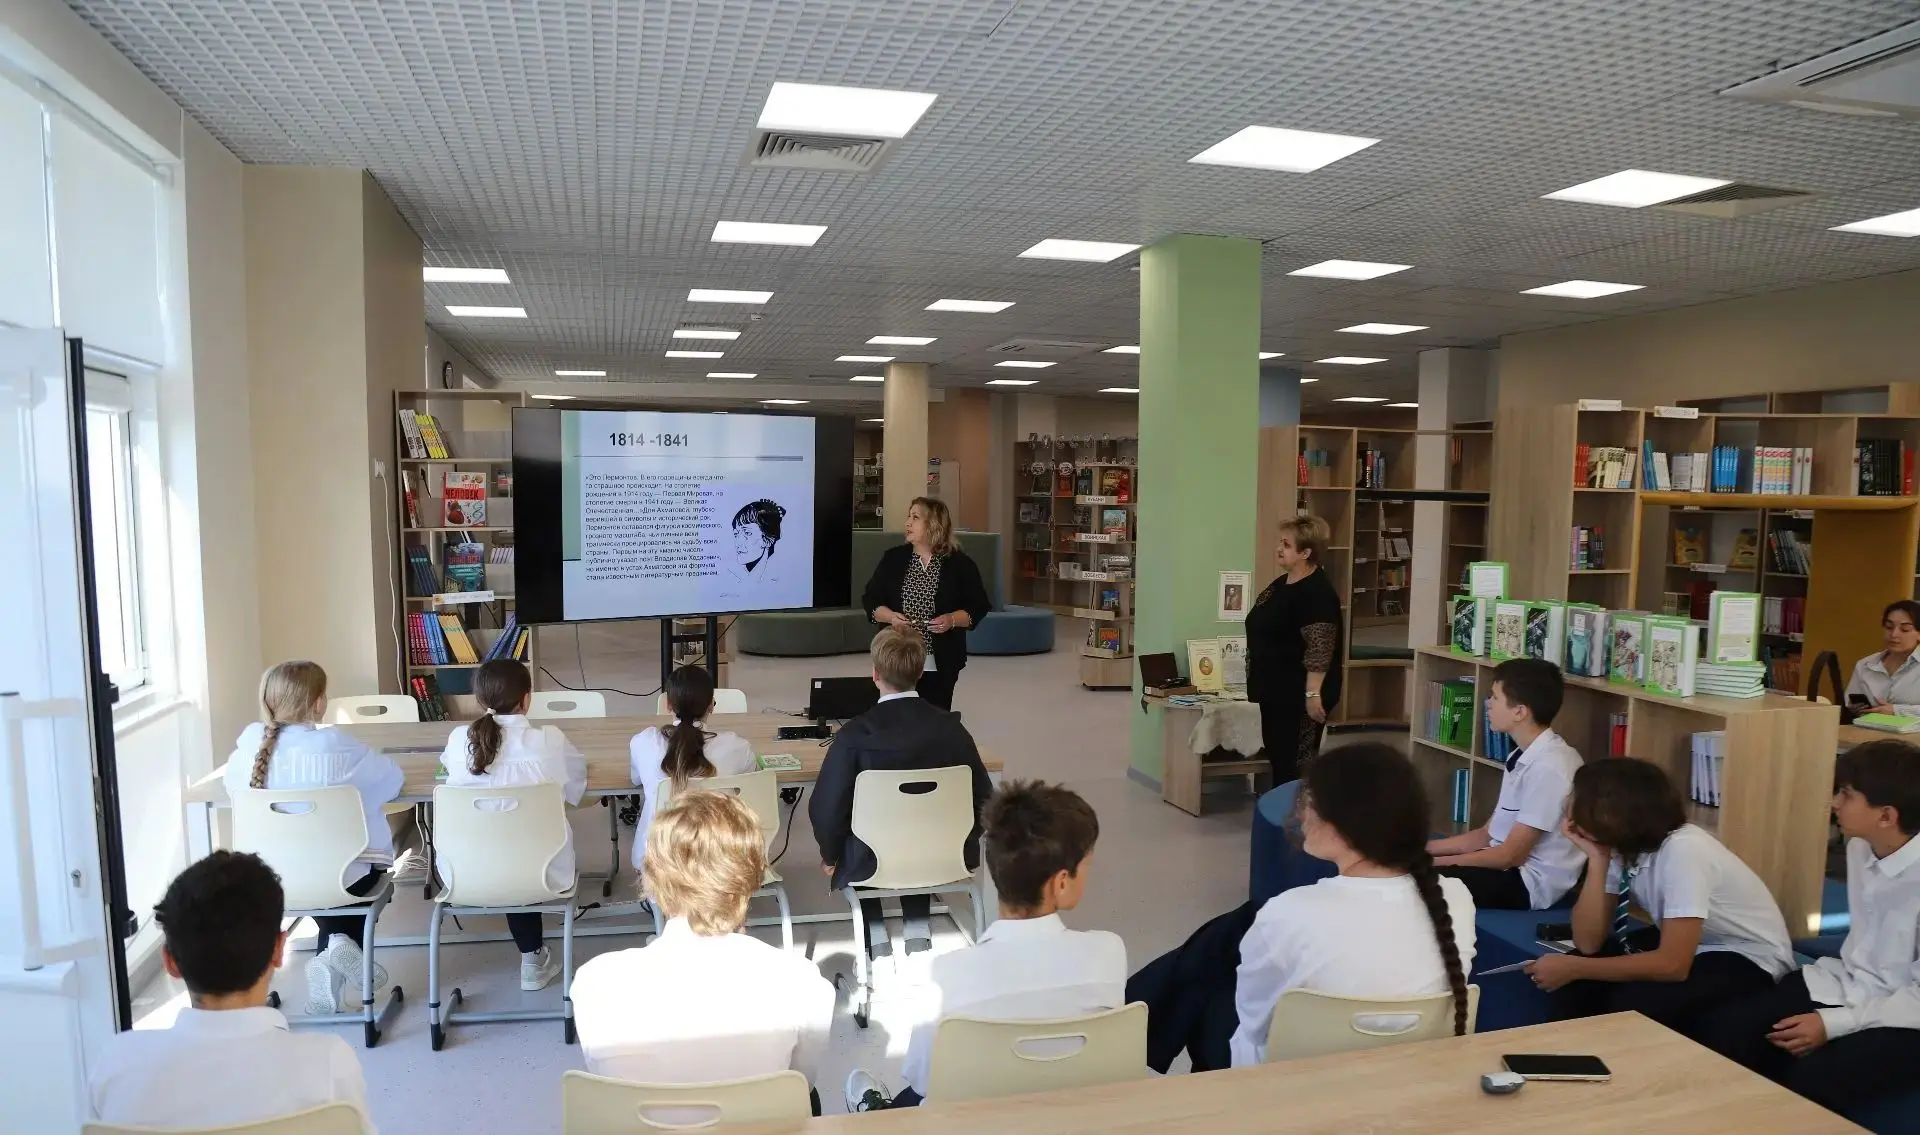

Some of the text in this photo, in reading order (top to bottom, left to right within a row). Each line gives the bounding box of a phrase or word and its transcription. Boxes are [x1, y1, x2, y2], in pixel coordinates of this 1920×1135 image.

[609, 432, 689, 447] 1814 -1841
[446, 489, 479, 500] ЧЕЛОВЕК
[662, 490, 685, 498] Первая
[658, 514, 699, 523] исторический
[585, 523, 620, 532] Лермонтов
